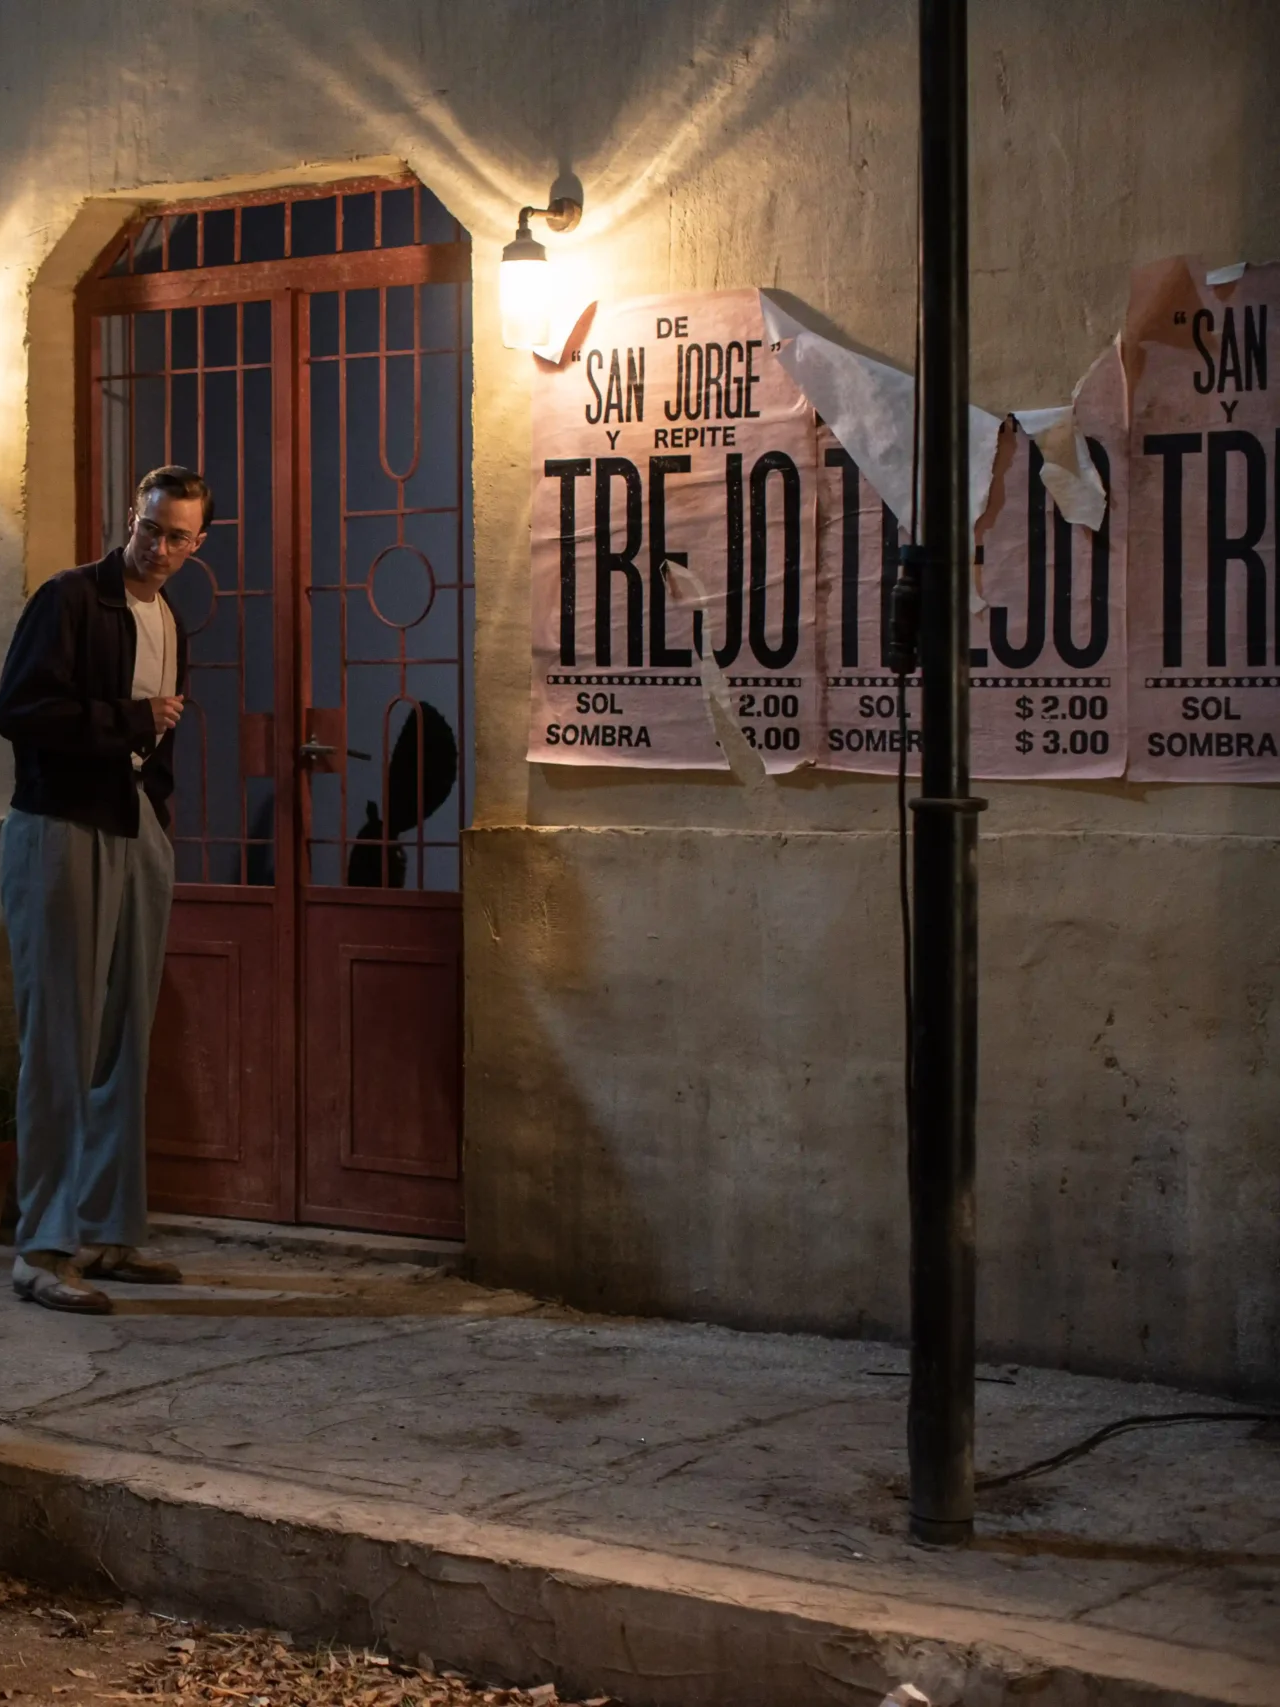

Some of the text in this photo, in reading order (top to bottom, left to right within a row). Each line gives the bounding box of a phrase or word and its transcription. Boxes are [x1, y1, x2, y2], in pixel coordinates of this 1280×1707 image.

[656, 316, 689, 339] DE
[1220, 400, 1239, 423] Y
[605, 425, 736, 450] Y REPITE
[544, 450, 801, 670] TREJO
[575, 691, 624, 715] SOL
[1181, 696, 1241, 721] SOL
[545, 723, 652, 748] SOMBRA
[828, 728, 924, 753] SOMBR
[1147, 732, 1279, 758] SOMBRA
